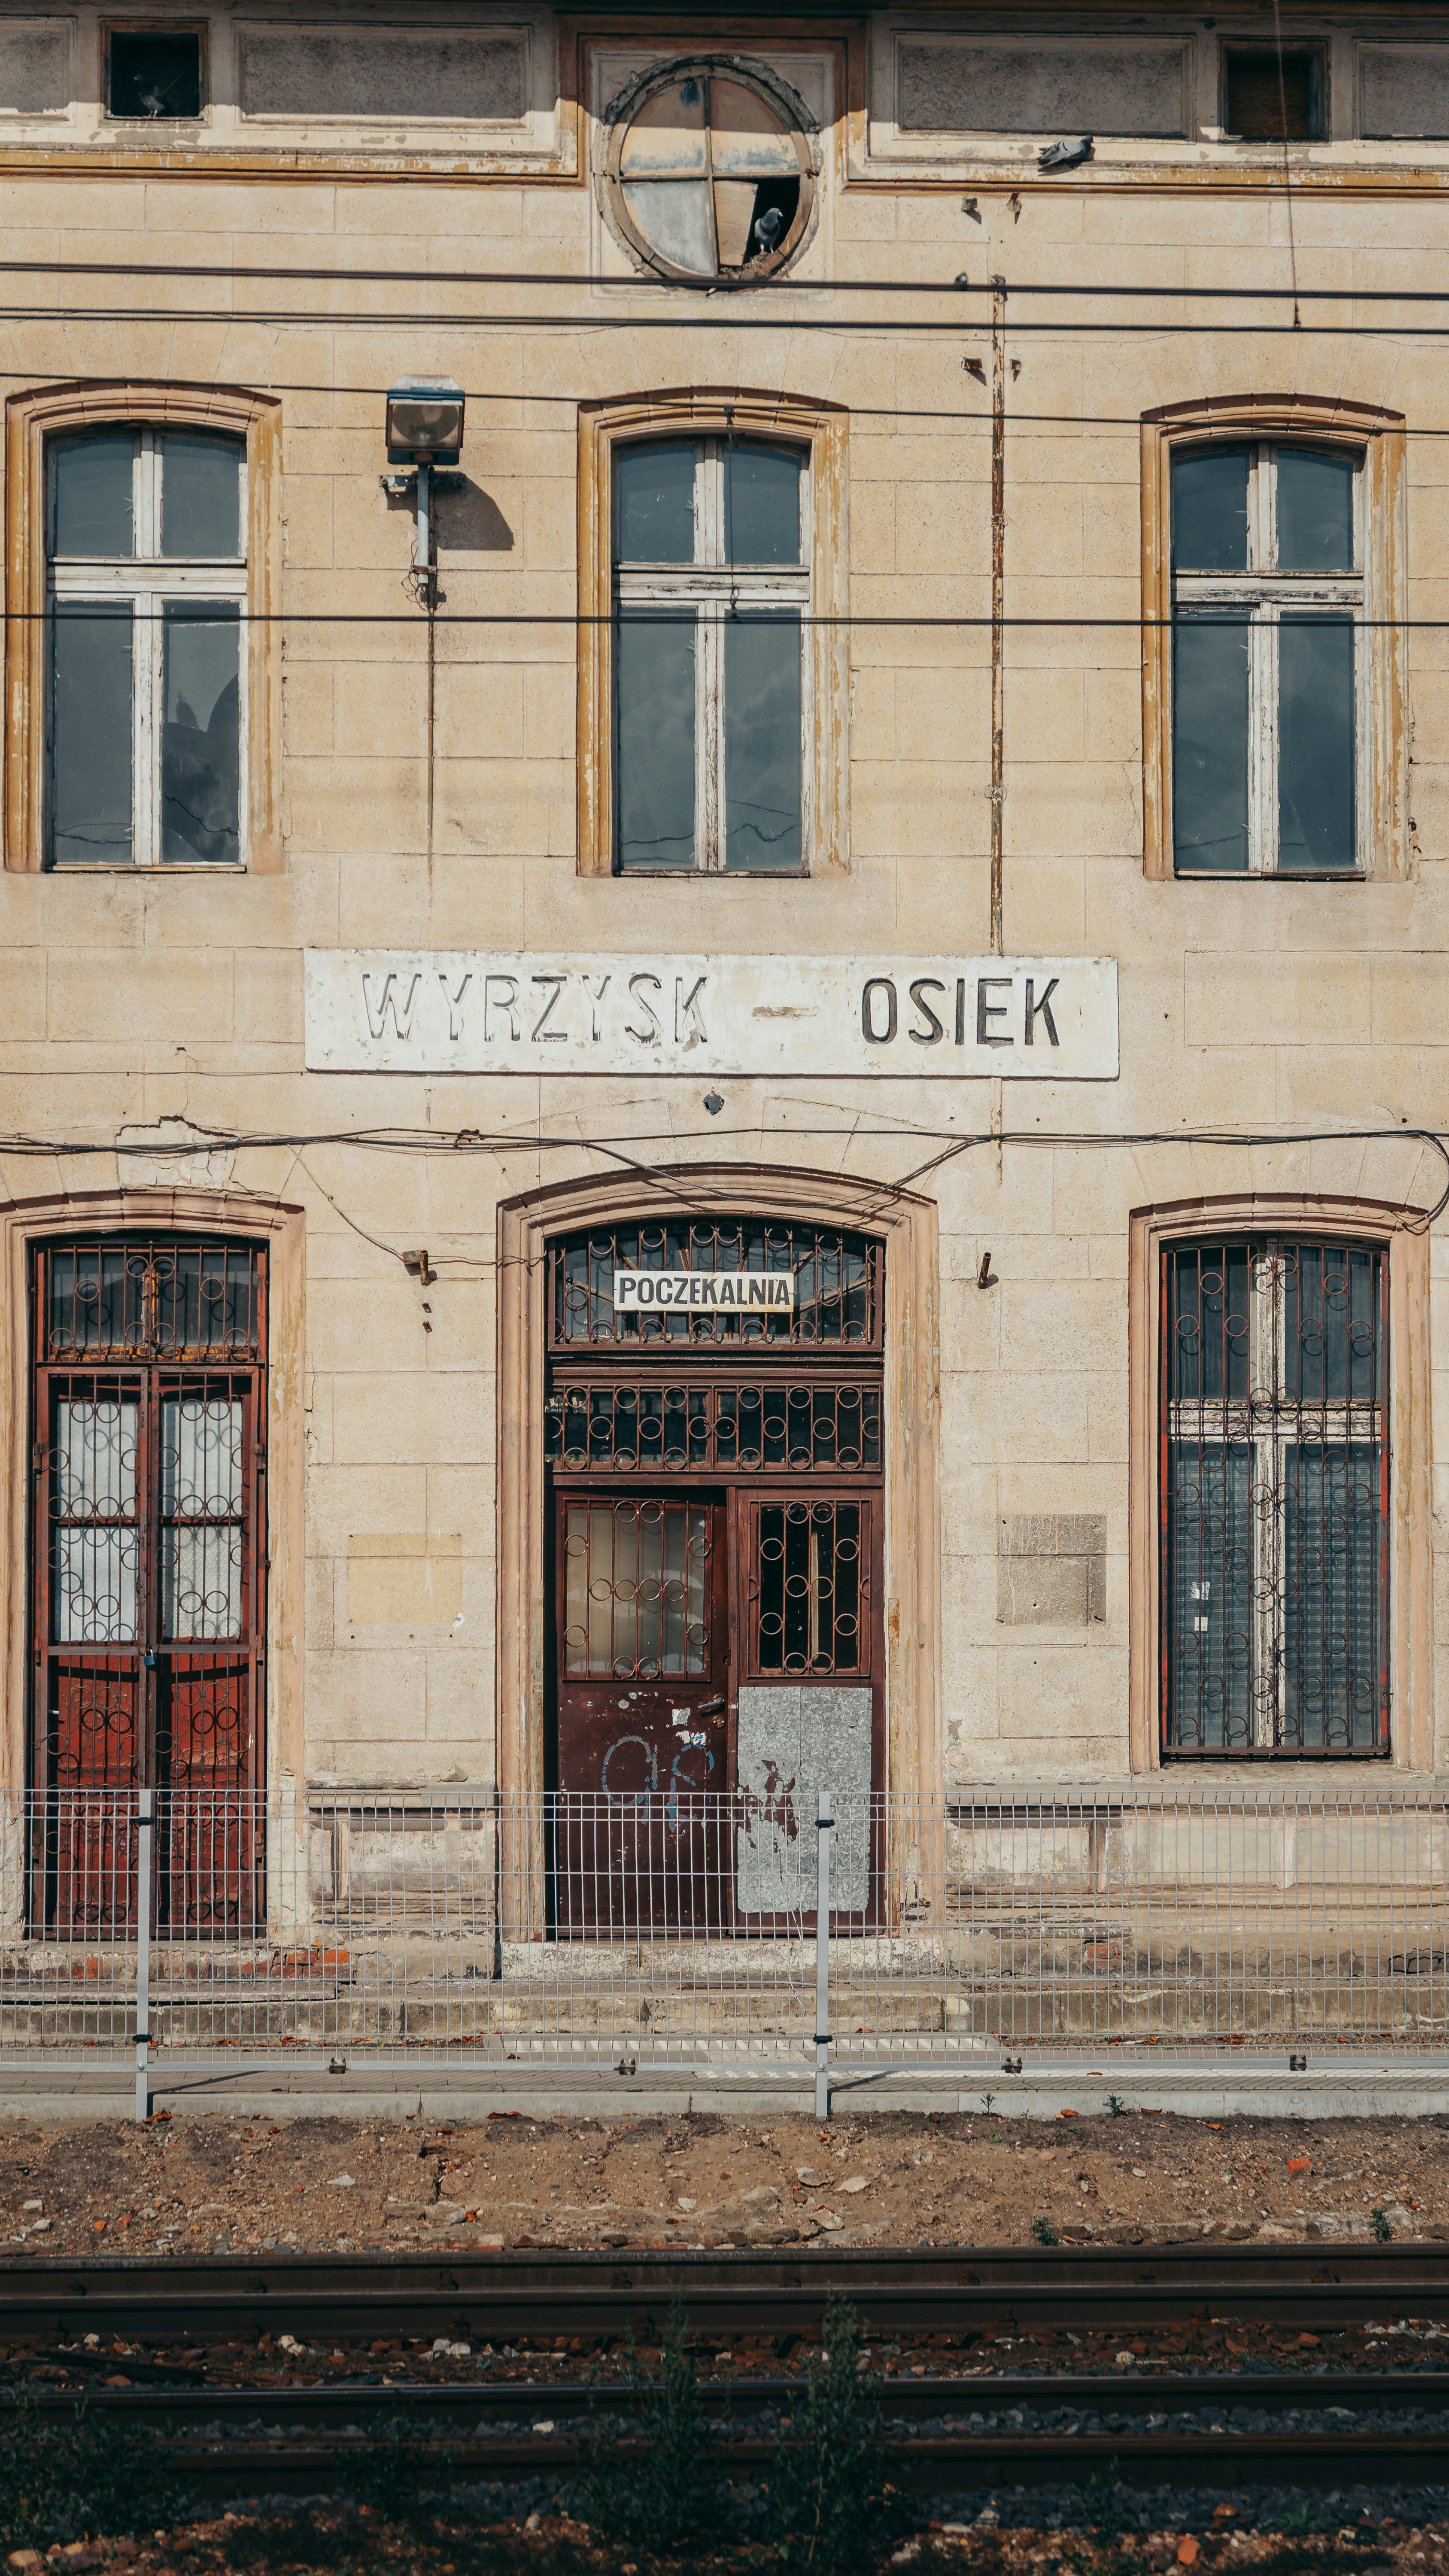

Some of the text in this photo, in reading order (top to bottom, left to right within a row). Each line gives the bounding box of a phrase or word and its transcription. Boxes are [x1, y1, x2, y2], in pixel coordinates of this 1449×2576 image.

[361, 973, 708, 1043] WYRZYSK
[862, 978, 1060, 1046] OSIEK
[619, 1277, 791, 1305] POCZEKALNIA
